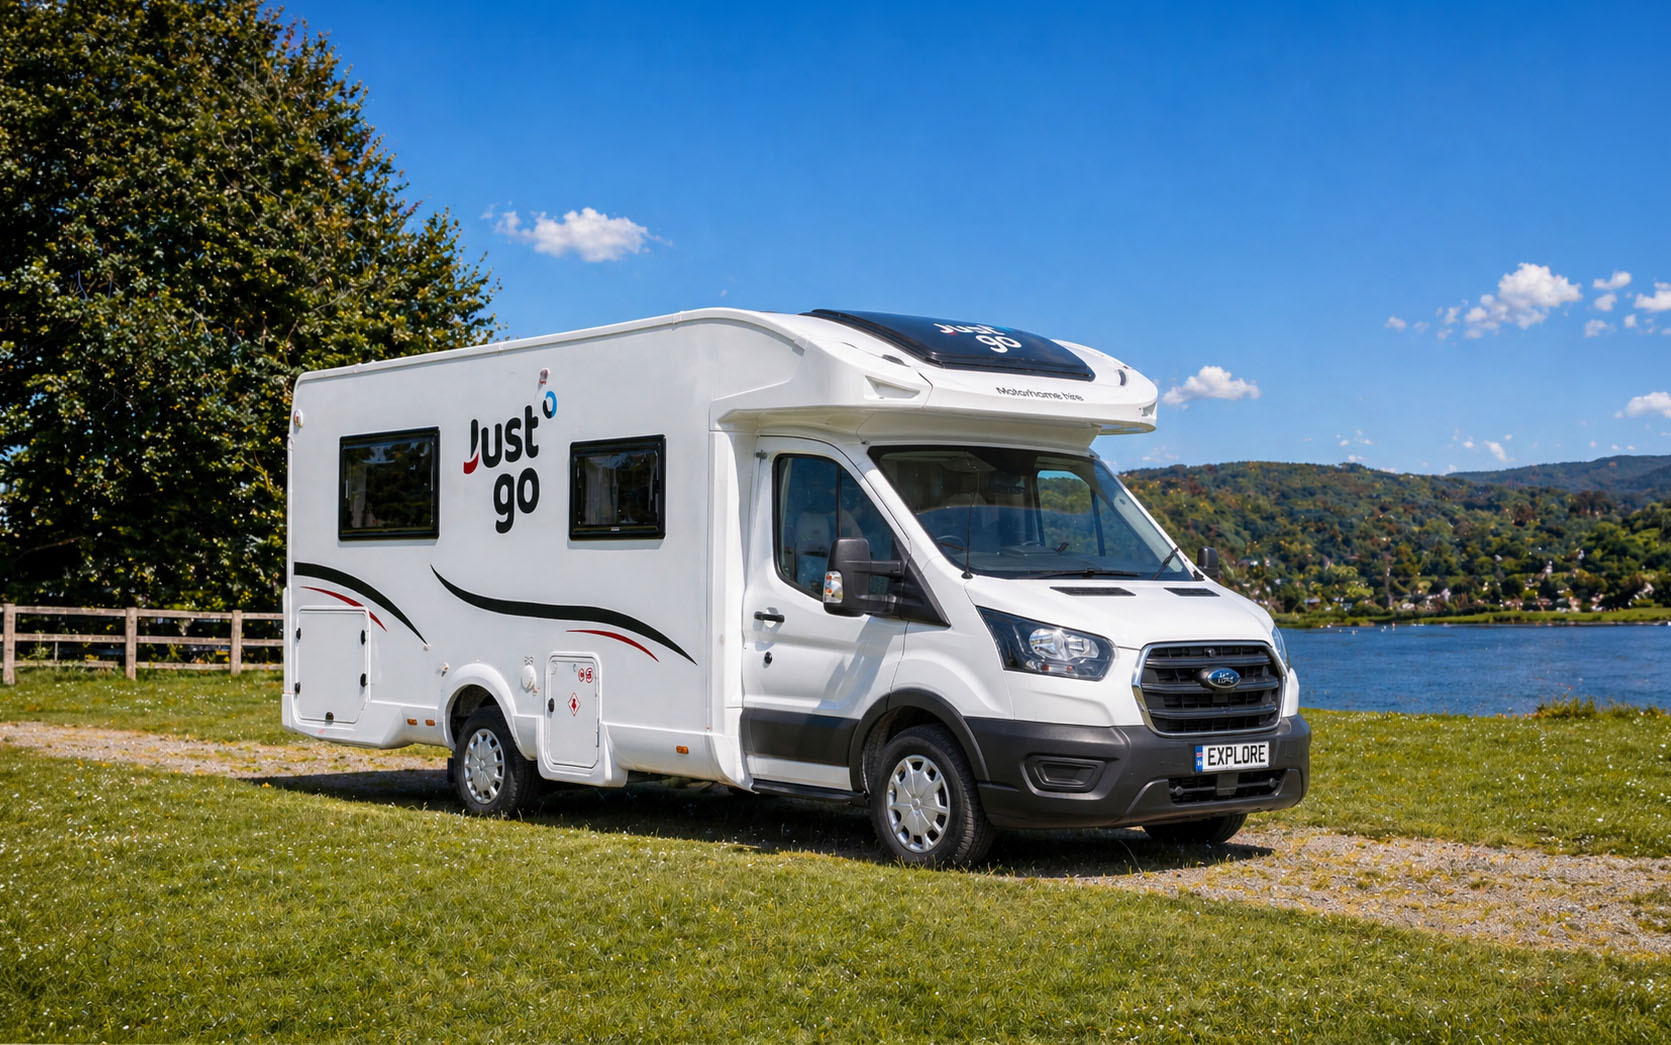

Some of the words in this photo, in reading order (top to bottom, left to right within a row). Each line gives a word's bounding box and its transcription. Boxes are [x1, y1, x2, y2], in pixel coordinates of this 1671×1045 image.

[933, 323, 1005, 336] Just
[975, 335, 1022, 353] go
[995, 386, 1062, 400] Motorhome
[1062, 391, 1084, 401] hire
[463, 405, 539, 474] Just
[494, 467, 540, 534] go
[1207, 744, 1266, 766] EXPLORE
